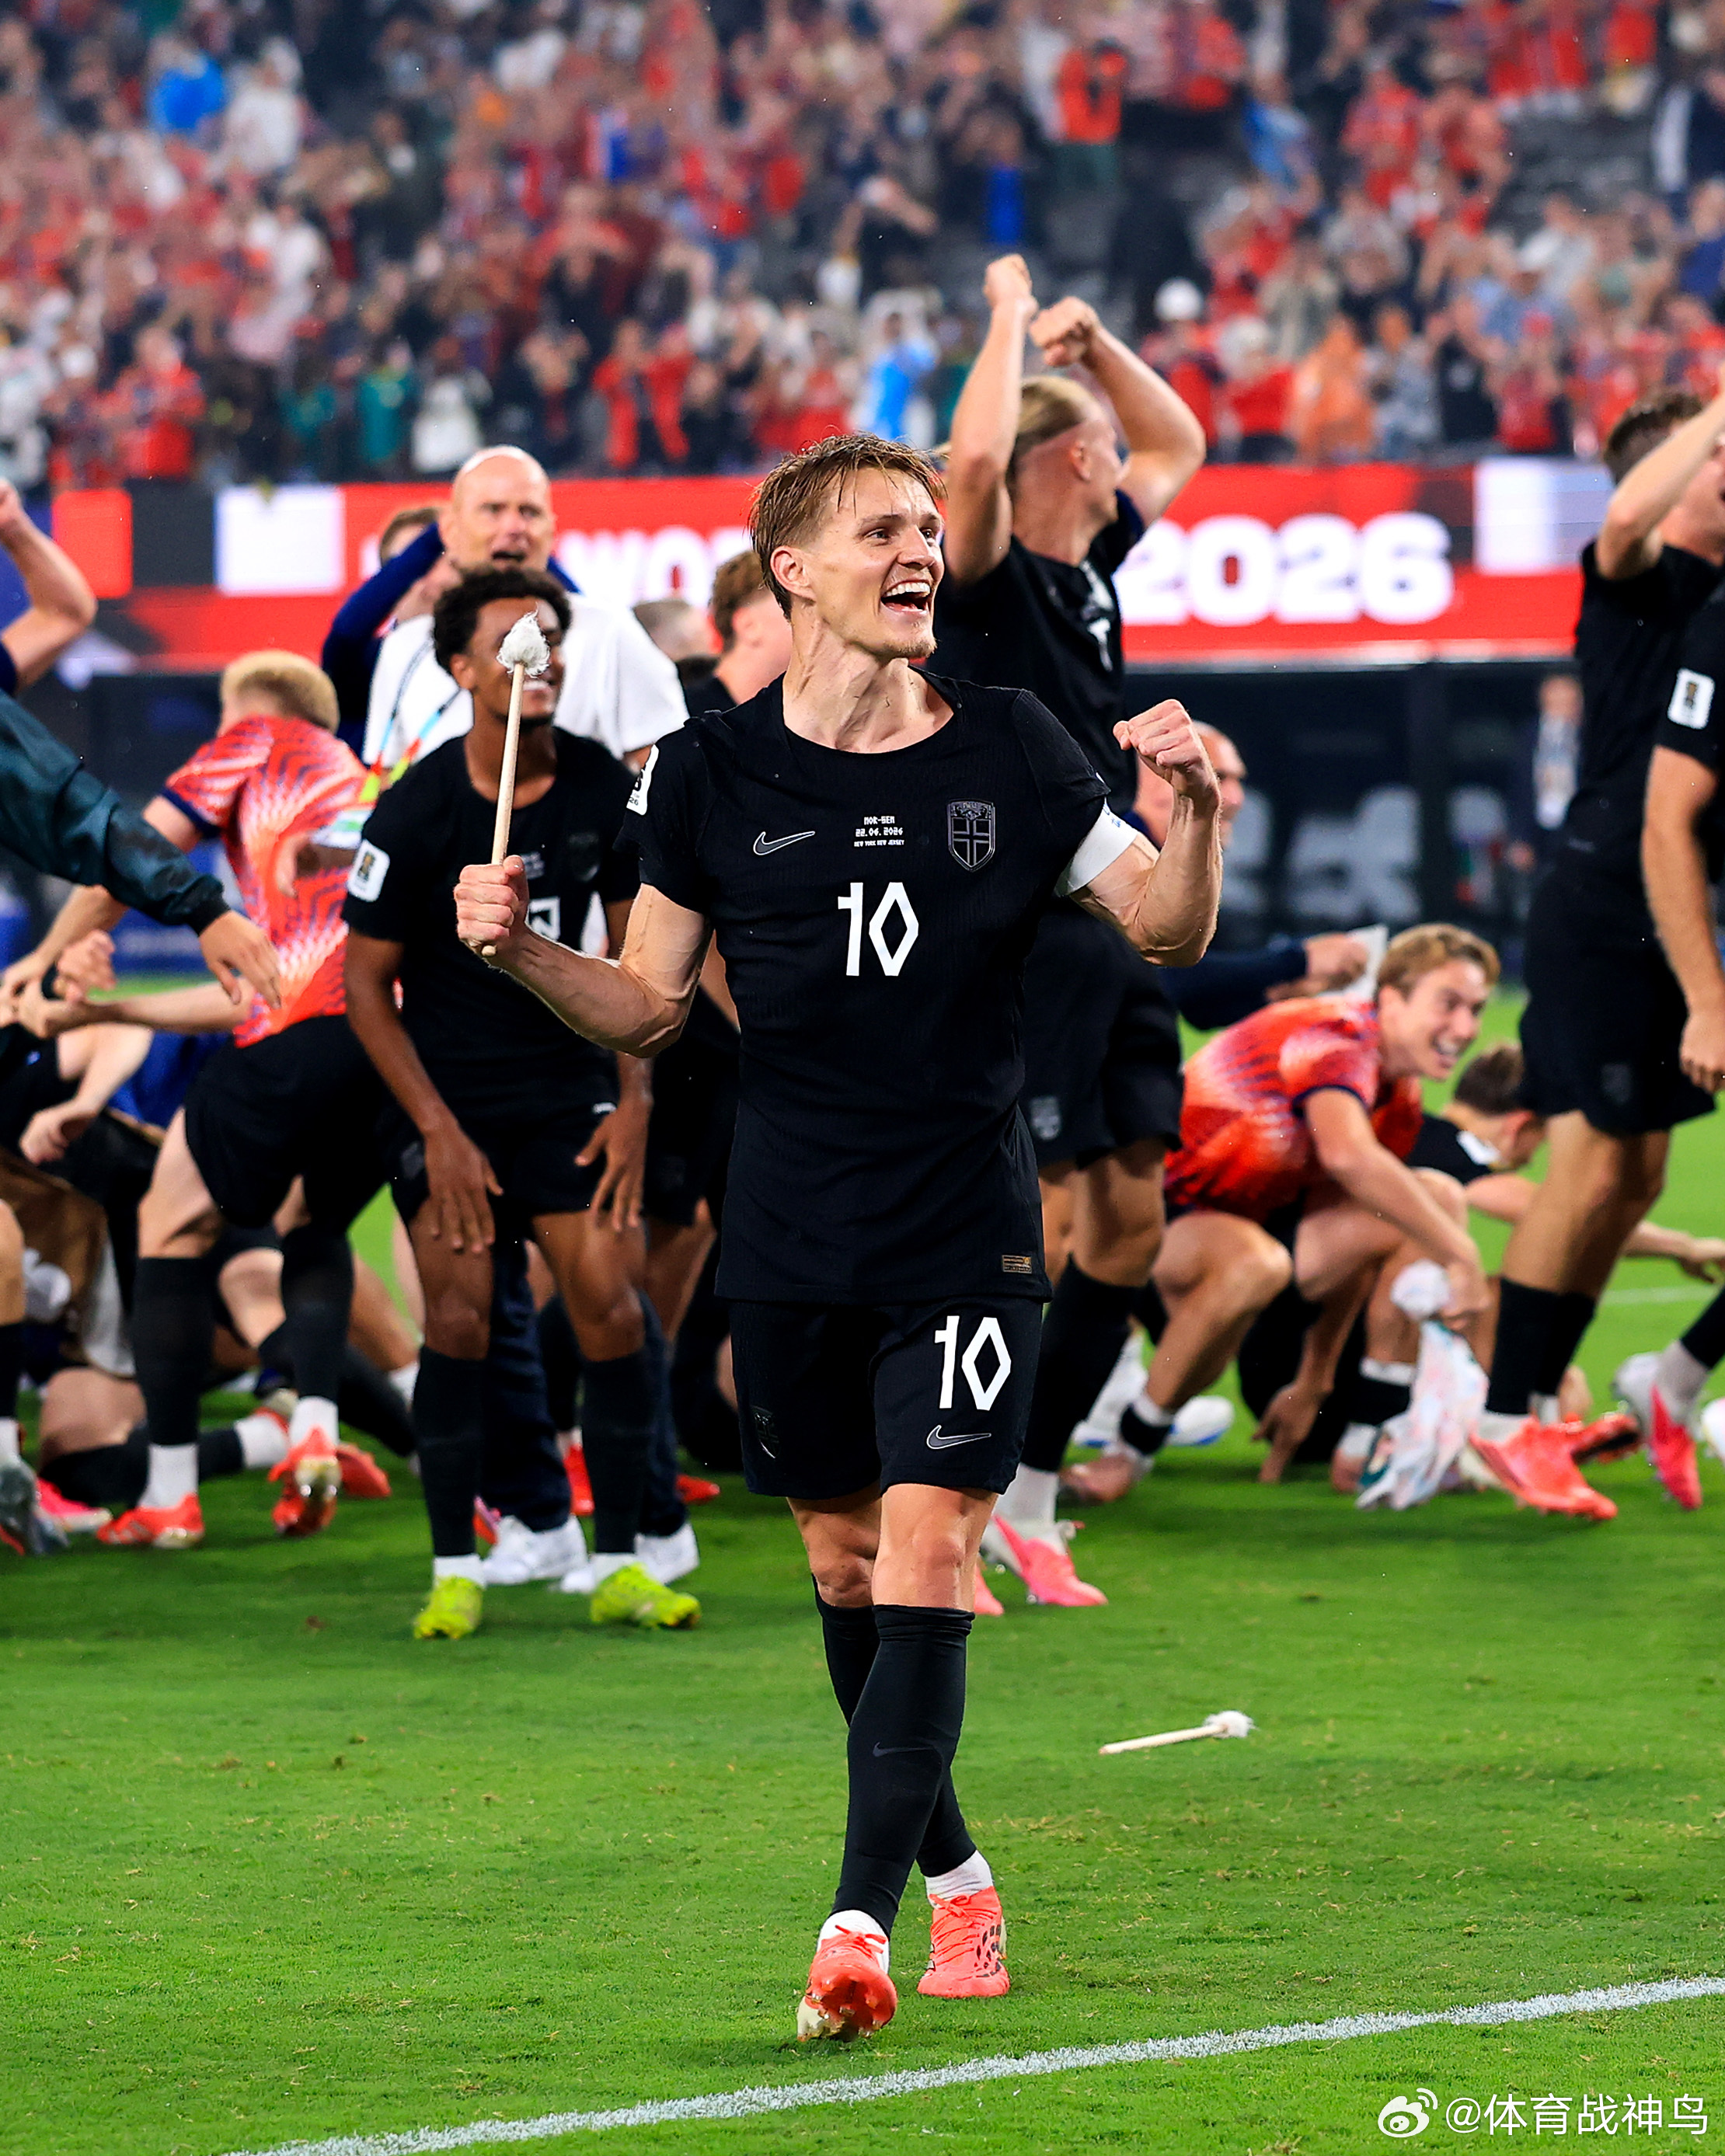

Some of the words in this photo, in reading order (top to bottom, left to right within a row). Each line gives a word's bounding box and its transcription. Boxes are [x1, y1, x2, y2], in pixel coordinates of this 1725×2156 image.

[1111, 511, 1462, 626] 2026
[863, 816, 895, 825] NOR-SEN
[838, 882, 918, 977] 10
[935, 1315, 1012, 1411] 10
